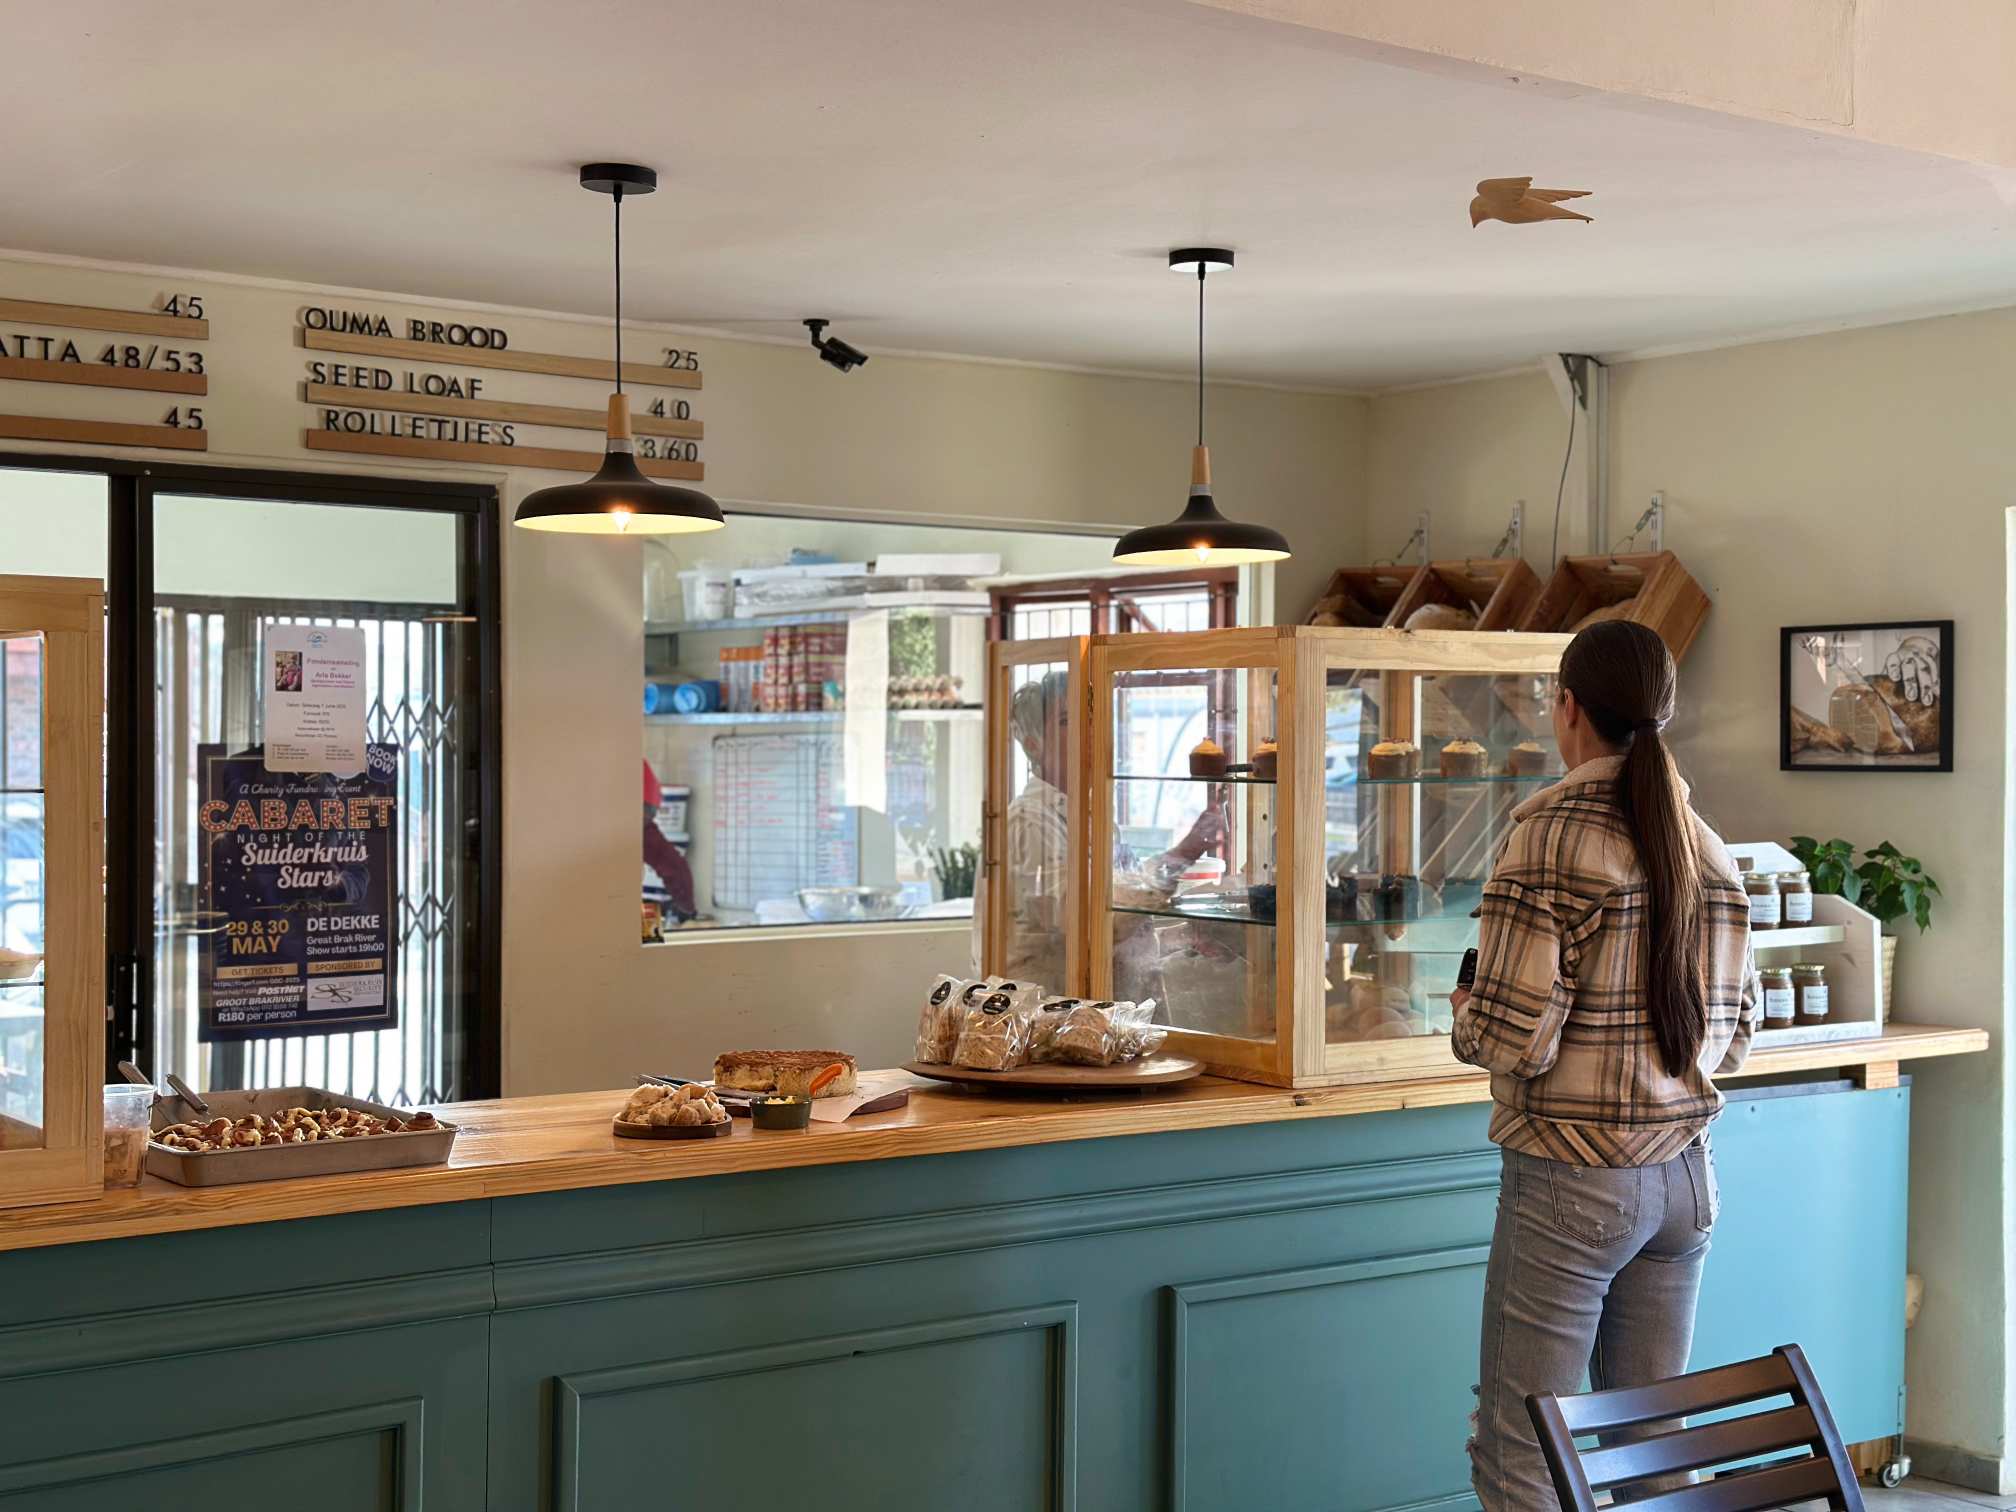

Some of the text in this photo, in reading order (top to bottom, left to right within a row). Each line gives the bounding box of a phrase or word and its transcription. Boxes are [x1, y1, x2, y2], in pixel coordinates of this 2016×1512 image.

[164, 294, 204, 320] 45
[305, 307, 699, 371] OUMA BROOD 25
[100, 344, 204, 375] 48/53
[311, 362, 690, 421] SEED LOAF 40
[164, 406, 204, 431] 45
[325, 408, 515, 447] ROLLETJIES
[366, 753, 395, 775] NOW
[368, 744, 395, 766] BOOK
[251, 783, 284, 798] Charity
[199, 797, 394, 832] CABARET
[237, 831, 367, 844] NIGHT OF THE
[241, 841, 369, 866] Suiderkruis
[277, 864, 335, 890] Stars
[226, 919, 289, 936] 29 & 30
[306, 915, 380, 932] DE DEKKE
[232, 935, 281, 956] MAY
[306, 933, 377, 945] Great Brak River
[306, 946, 330, 956] Show
[331, 945, 358, 954] starts
[215, 998, 248, 1008] GROOT
[218, 1010, 297, 1023] R180 per person
